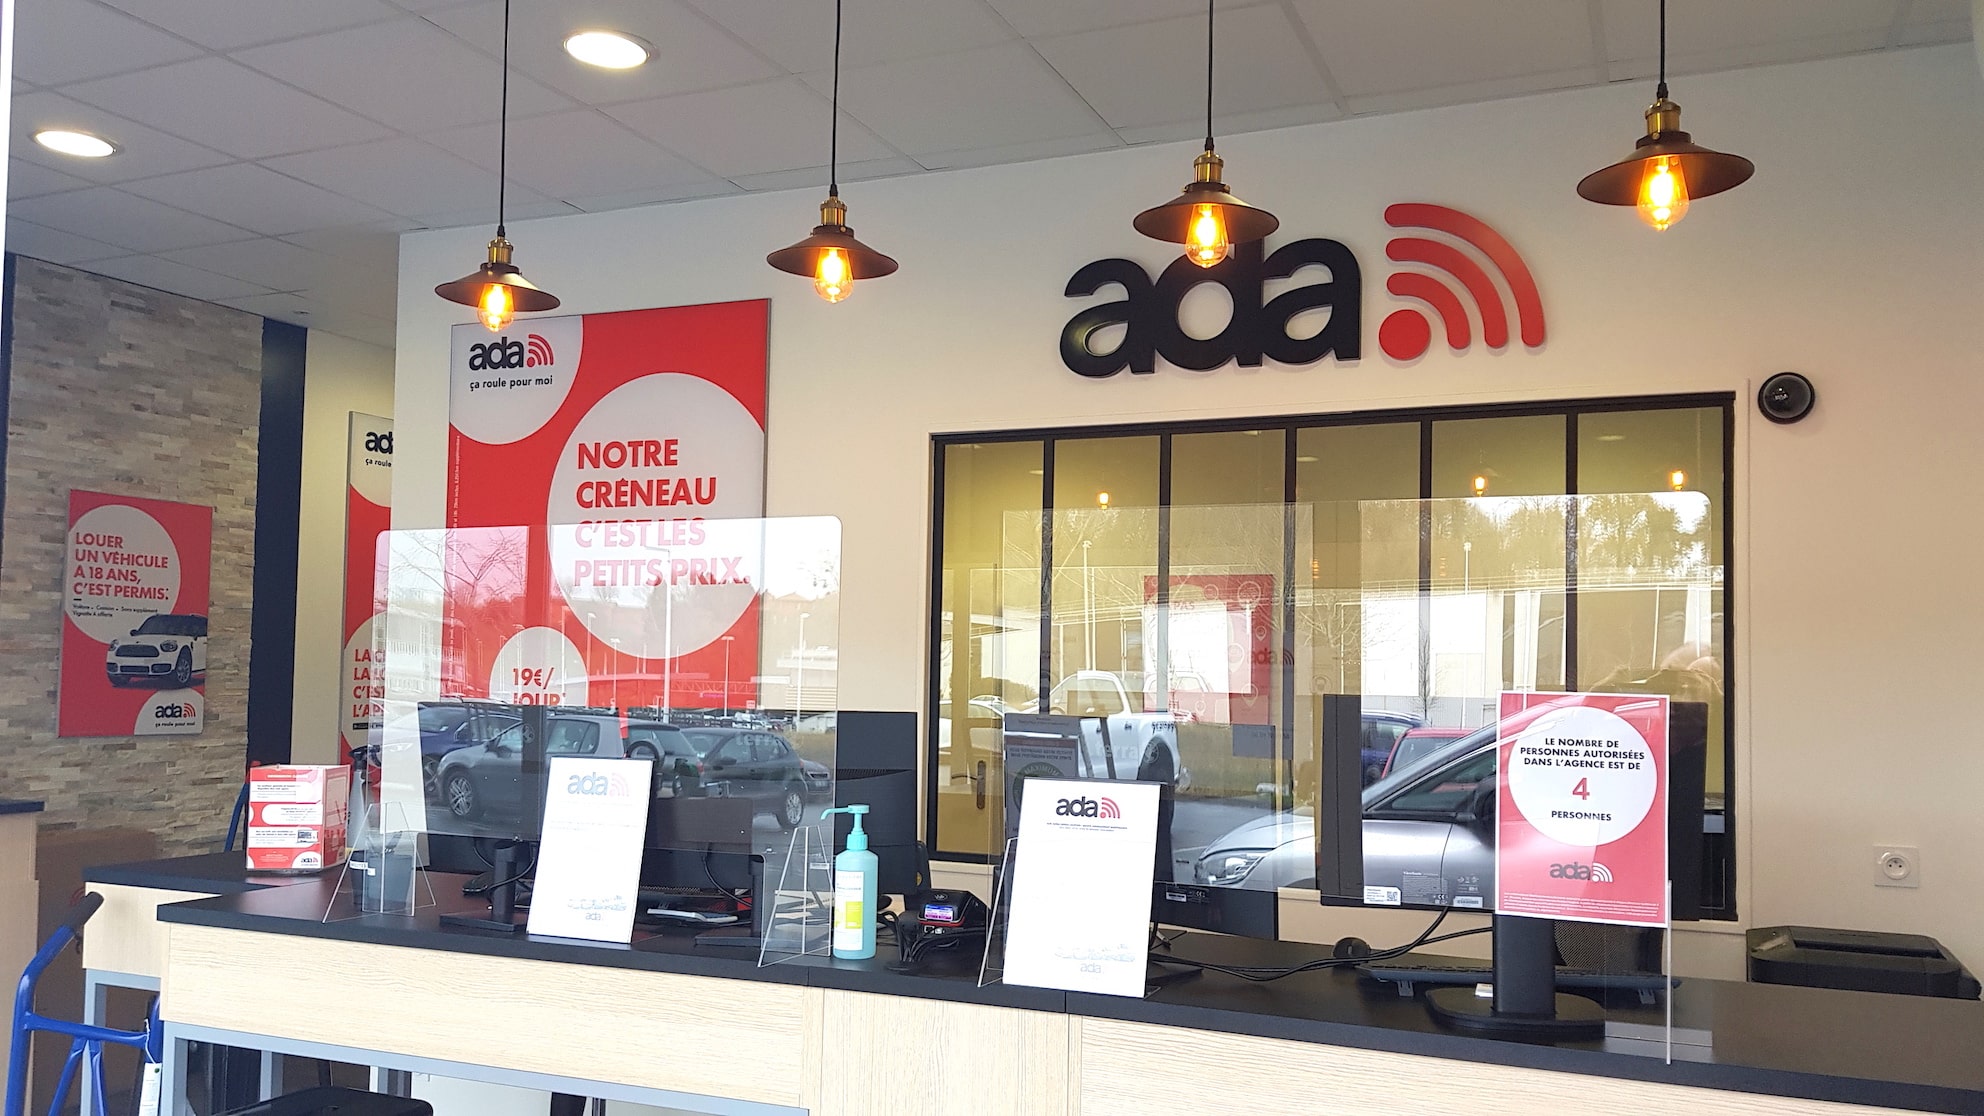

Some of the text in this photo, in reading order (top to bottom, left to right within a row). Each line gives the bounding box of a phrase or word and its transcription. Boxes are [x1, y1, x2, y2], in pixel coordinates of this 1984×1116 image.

[1059, 236, 1362, 378] ada
[468, 336, 525, 371] ada
[469, 375, 553, 392] ça roule pour moi
[365, 431, 394, 455] ad
[365, 458, 392, 467] ça roule
[577, 438, 679, 470] NOTRE
[575, 477, 717, 509] CRÉNEAU
[75, 532, 123, 549] LOUER
[574, 517, 706, 548] C'EST LES
[75, 549, 168, 569] UN VÉHICULE
[89, 566, 104, 580] 18
[106, 567, 142, 585] ANS,
[574, 556, 751, 587] PETITS PRIX.
[73, 582, 112, 597] C'EST
[354, 648, 371, 662] LA
[353, 667, 371, 681] LA
[512, 667, 555, 690] 19€/
[155, 703, 182, 718] ada
[1545, 737, 1619, 748] LE NOMBRE DE
[1520, 747, 1645, 760] PERSONNES AUTORISÉES
[1524, 757, 1641, 770] DANS L'AGENCE EST DE
[567, 771, 609, 796] ada
[1572, 777, 1591, 801] 4
[1055, 796, 1099, 818] ada
[1551, 810, 1612, 821] PERSONNES
[1549, 862, 1591, 881] ada
